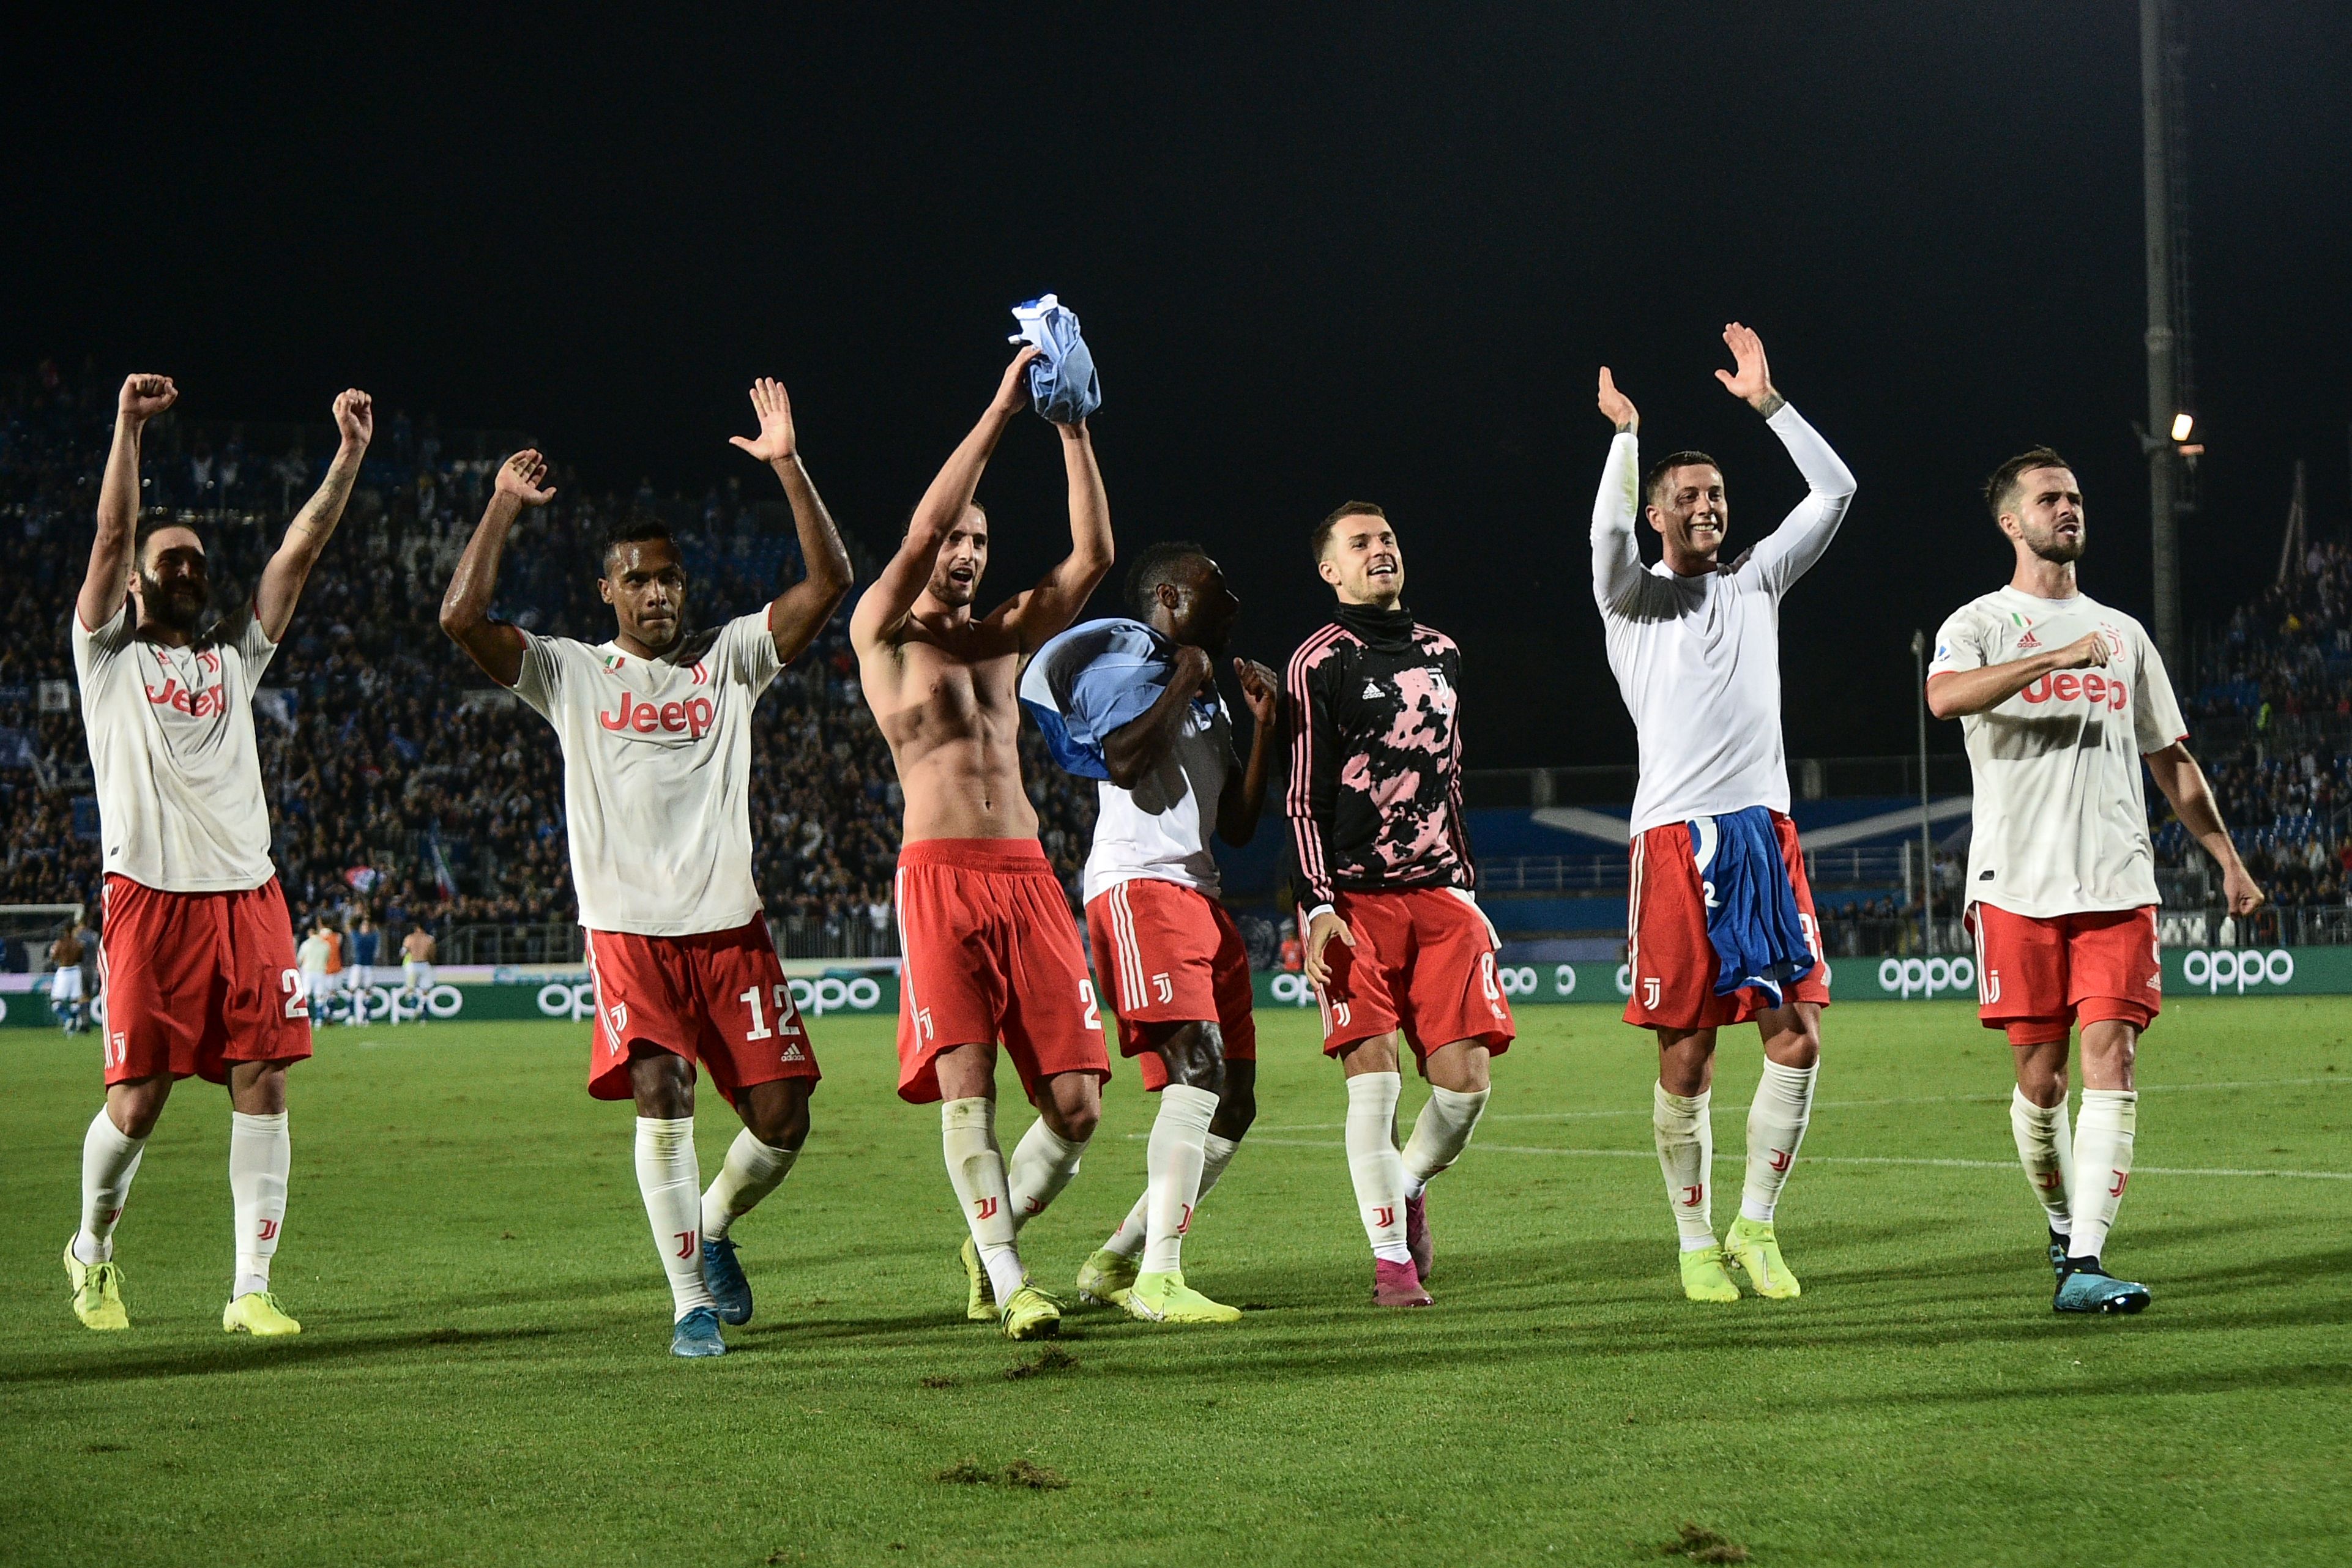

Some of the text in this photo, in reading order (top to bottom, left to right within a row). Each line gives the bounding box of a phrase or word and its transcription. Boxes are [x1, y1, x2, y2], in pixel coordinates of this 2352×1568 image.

[146, 678, 226, 718] Jeep
[600, 691, 713, 738] Jeep
[2021, 672, 2127, 714] Jeep
[281, 968, 309, 1019] 2
[1878, 956, 1975, 1000] oppo
[2183, 949, 2294, 995] oppo
[740, 984, 800, 1041] 12
[1078, 978, 1102, 1030] 2
[781, 1053, 806, 1062] adidas
